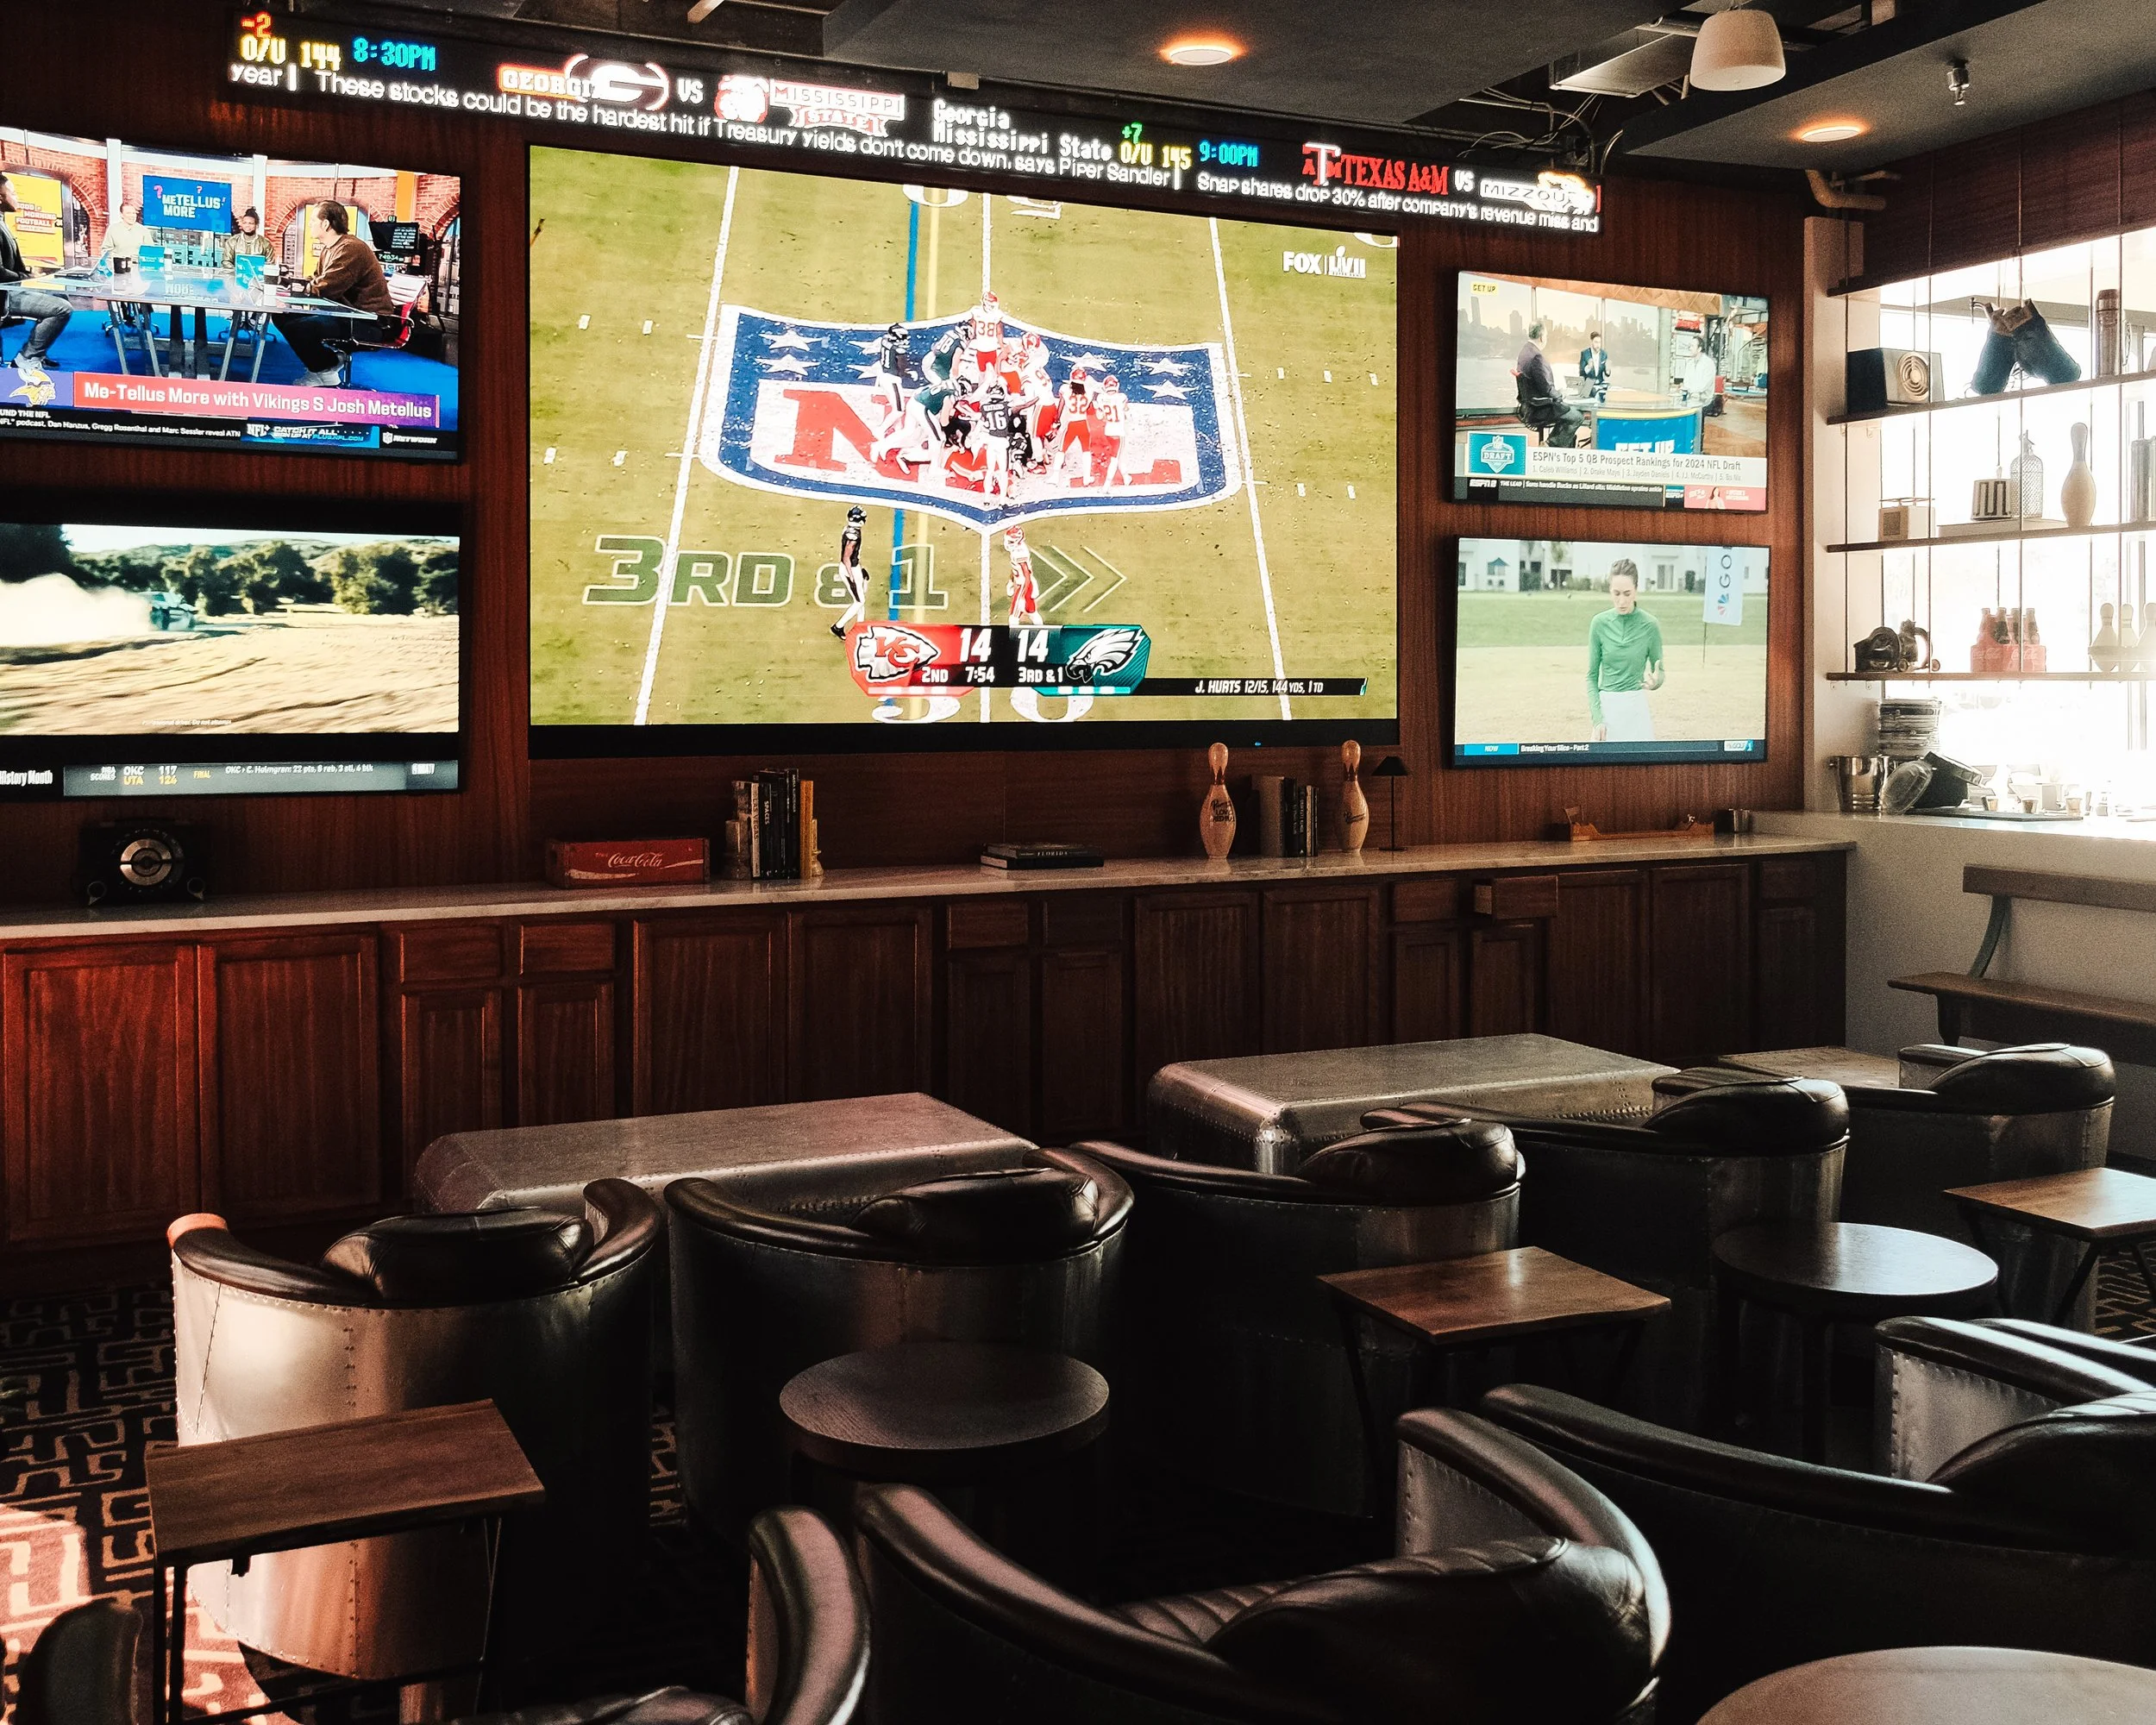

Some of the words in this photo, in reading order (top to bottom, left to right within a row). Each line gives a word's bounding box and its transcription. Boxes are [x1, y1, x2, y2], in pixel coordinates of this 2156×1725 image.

[241, 12, 272, 38] -2
[300, 41, 341, 71] 144
[352, 37, 436, 72] 8:30PM
[677, 78, 704, 104] VS
[775, 85, 902, 114] MISSISSIPPI
[807, 108, 874, 130] STATE
[933, 97, 1010, 129] Georgia
[933, 121, 1049, 154] Mississippi
[1059, 133, 1112, 161] State
[1121, 122, 1143, 144] +7
[230, 64, 284, 87] year
[316, 71, 385, 99] These
[390, 82, 459, 109] stocks
[463, 92, 521, 116] could
[526, 96, 553, 119] be
[556, 99, 588, 123] the
[592, 104, 667, 132] hardest
[670, 112, 695, 135] hit
[698, 116, 711, 136] if
[714, 119, 799, 147] Treasury
[802, 129, 857, 154] yields
[906, 143, 956, 164] come
[1014, 154, 1056, 175] says
[1059, 156, 1104, 180] Piper
[1106, 162, 1171, 187] Sandler
[1197, 171, 1240, 194] Snap
[1241, 177, 1293, 200] shares
[1294, 183, 1331, 204] drop
[1332, 187, 1366, 208] 30%
[1368, 191, 1401, 211] after
[1401, 198, 1478, 220] company's
[1480, 205, 1536, 226] revenue
[1538, 211, 1570, 230] miss
[1570, 216, 1600, 233] and
[1162, 145, 1192, 170] 145
[1199, 140, 1260, 167] 9:00PM
[1340, 154, 1406, 191] TEXAS
[1407, 162, 1449, 196] A&M
[1454, 170, 1475, 192] VS
[162, 194, 221, 209] METELLUS
[163, 204, 196, 218] MORE
[1282, 250, 1322, 275] FOX
[1473, 284, 1485, 292] GET
[975, 321, 995, 337] 38
[85, 381, 166, 404] Me-Tellus
[168, 386, 210, 405] More
[213, 390, 248, 408] with
[252, 392, 310, 412] Vikings
[313, 396, 324, 413] S
[327, 397, 365, 415] Josh
[367, 400, 432, 419] Metellus
[1069, 396, 1087, 414] 32
[17, 410, 34, 418] THE
[1103, 405, 1120, 423] 21
[91, 423, 113, 431] Gregg
[1483, 452, 1512, 461] DRAFT
[1532, 451, 1561, 462] ESPN's
[1563, 452, 1576, 465] Top
[1578, 454, 1584, 463] 5
[1586, 454, 1598, 465] QB
[1600, 455, 1633, 467] Prospect
[1636, 456, 1670, 468] Rankings
[1673, 457, 1683, 467] for
[1685, 458, 1704, 468] 2024
[1707, 460, 1720, 469] NFL
[1723, 461, 1741, 470] Draft
[582, 534, 795, 607] 3RD
[888, 543, 949, 611] 1
[874, 636, 922, 668] KC
[959, 628, 993, 663] 14
[1017, 628, 1050, 663] 14
[921, 667, 950, 683] 2ND
[964, 666, 995, 683] 7:54
[1018, 667, 1044, 683] 3RD
[1046, 667, 1057, 683] &
[1194, 680, 1206, 693] J.
[1207, 680, 1241, 693] HURTS
[1244, 680, 1269, 694] 12/15,
[1272, 680, 1288, 693] 144
[1288, 681, 1305, 694] YDS,
[1313, 681, 1324, 693] TD
[123, 766, 145, 776] OKC
[159, 765, 178, 775] 117
[123, 775, 144, 786] UTA
[293, 765, 303, 774] 22
[607, 851, 663, 869] Coca-Cola
